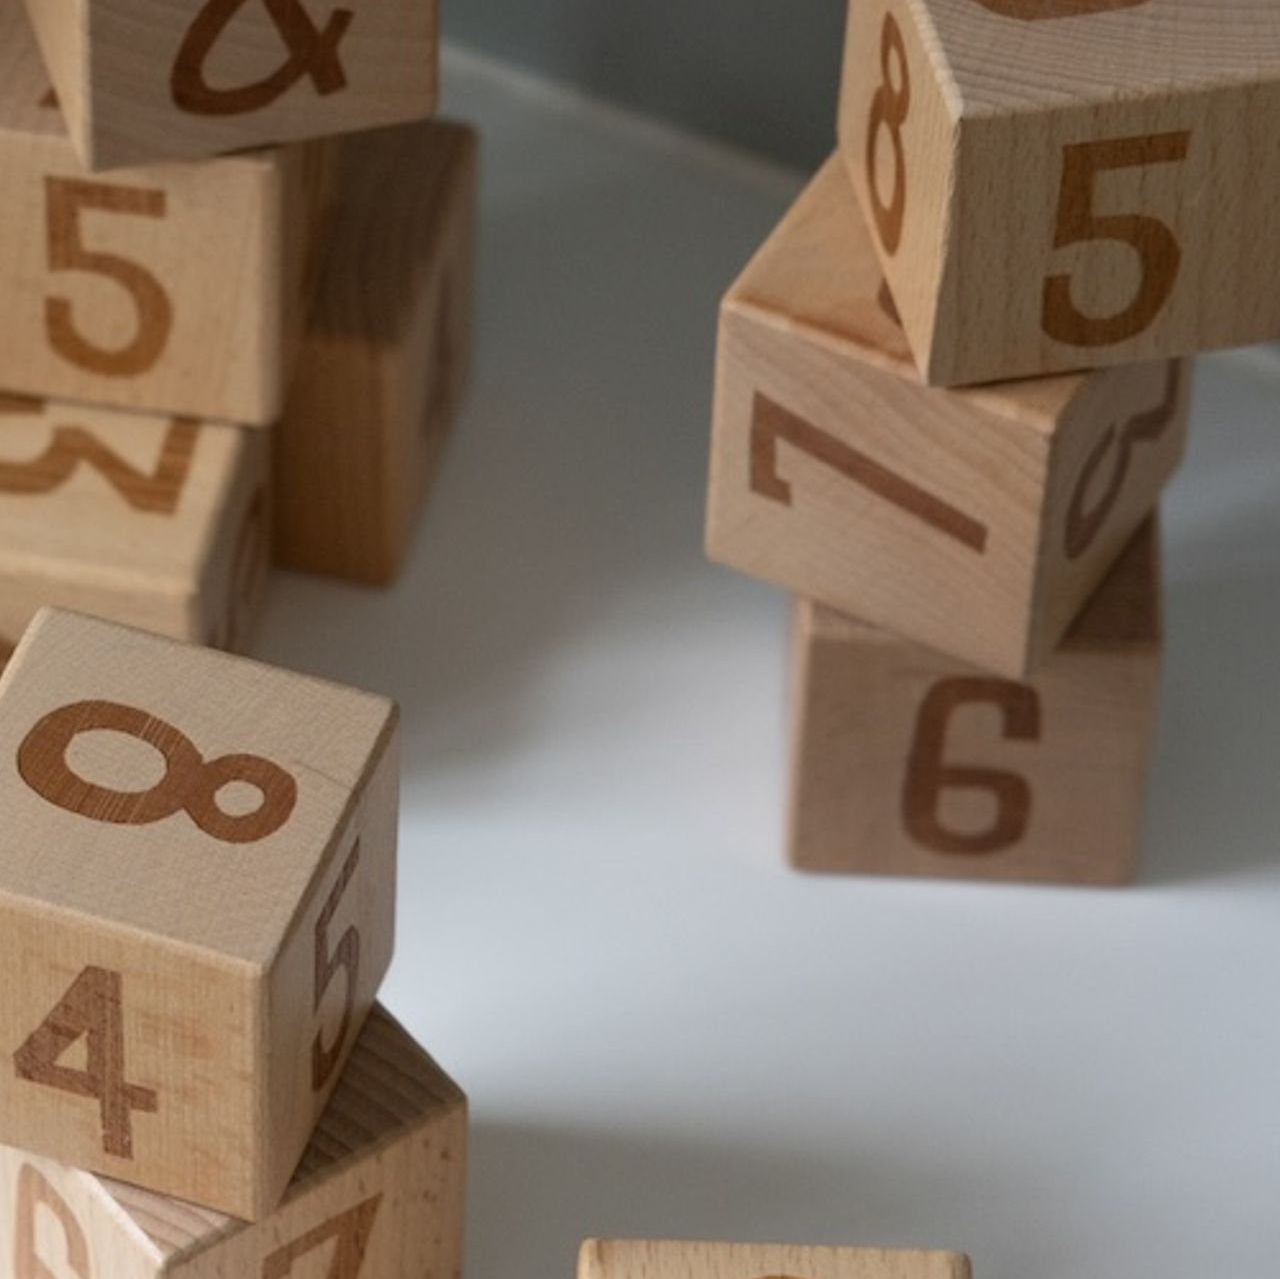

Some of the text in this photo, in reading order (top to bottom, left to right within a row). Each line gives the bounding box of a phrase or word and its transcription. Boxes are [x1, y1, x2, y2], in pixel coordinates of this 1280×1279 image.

[866, 10, 910, 258] 8
[43, 174, 174, 379] 5
[1040, 129, 1194, 349] 5
[17, 699, 298, 844] 8
[901, 676, 1042, 857] 6
[12, 964, 158, 1160] 4
[310, 835, 361, 1094] 5
